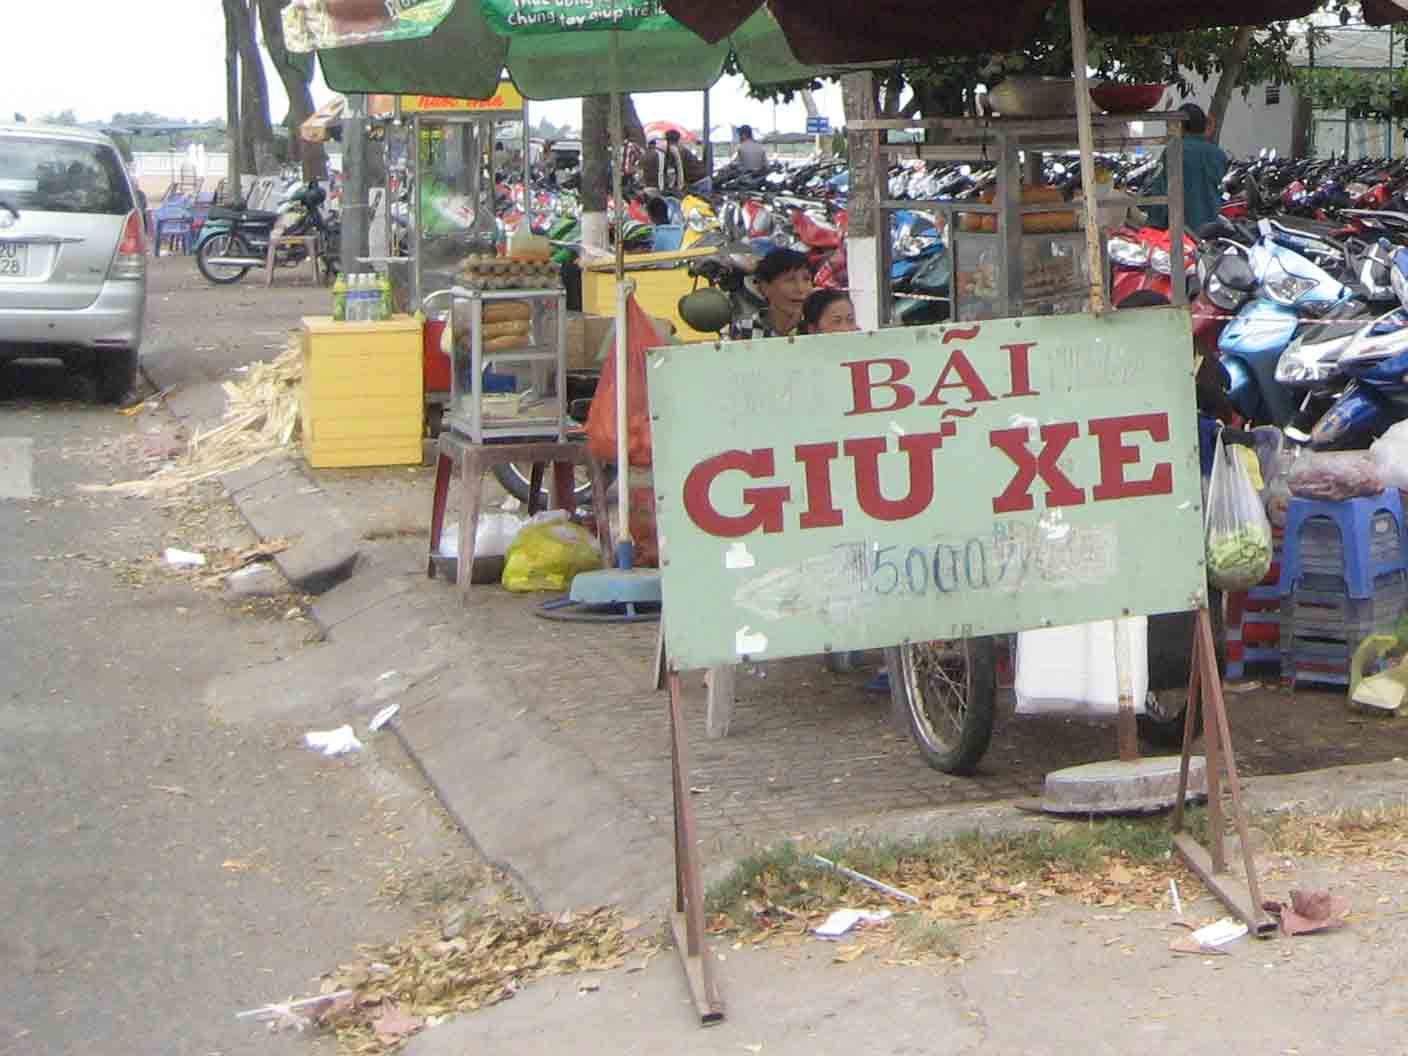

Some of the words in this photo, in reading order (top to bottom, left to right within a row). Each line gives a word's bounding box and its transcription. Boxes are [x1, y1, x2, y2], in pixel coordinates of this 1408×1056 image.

[840, 325, 1041, 416] BÃI
[682, 407, 977, 538] GIỮ
[989, 412, 1173, 514] XE
